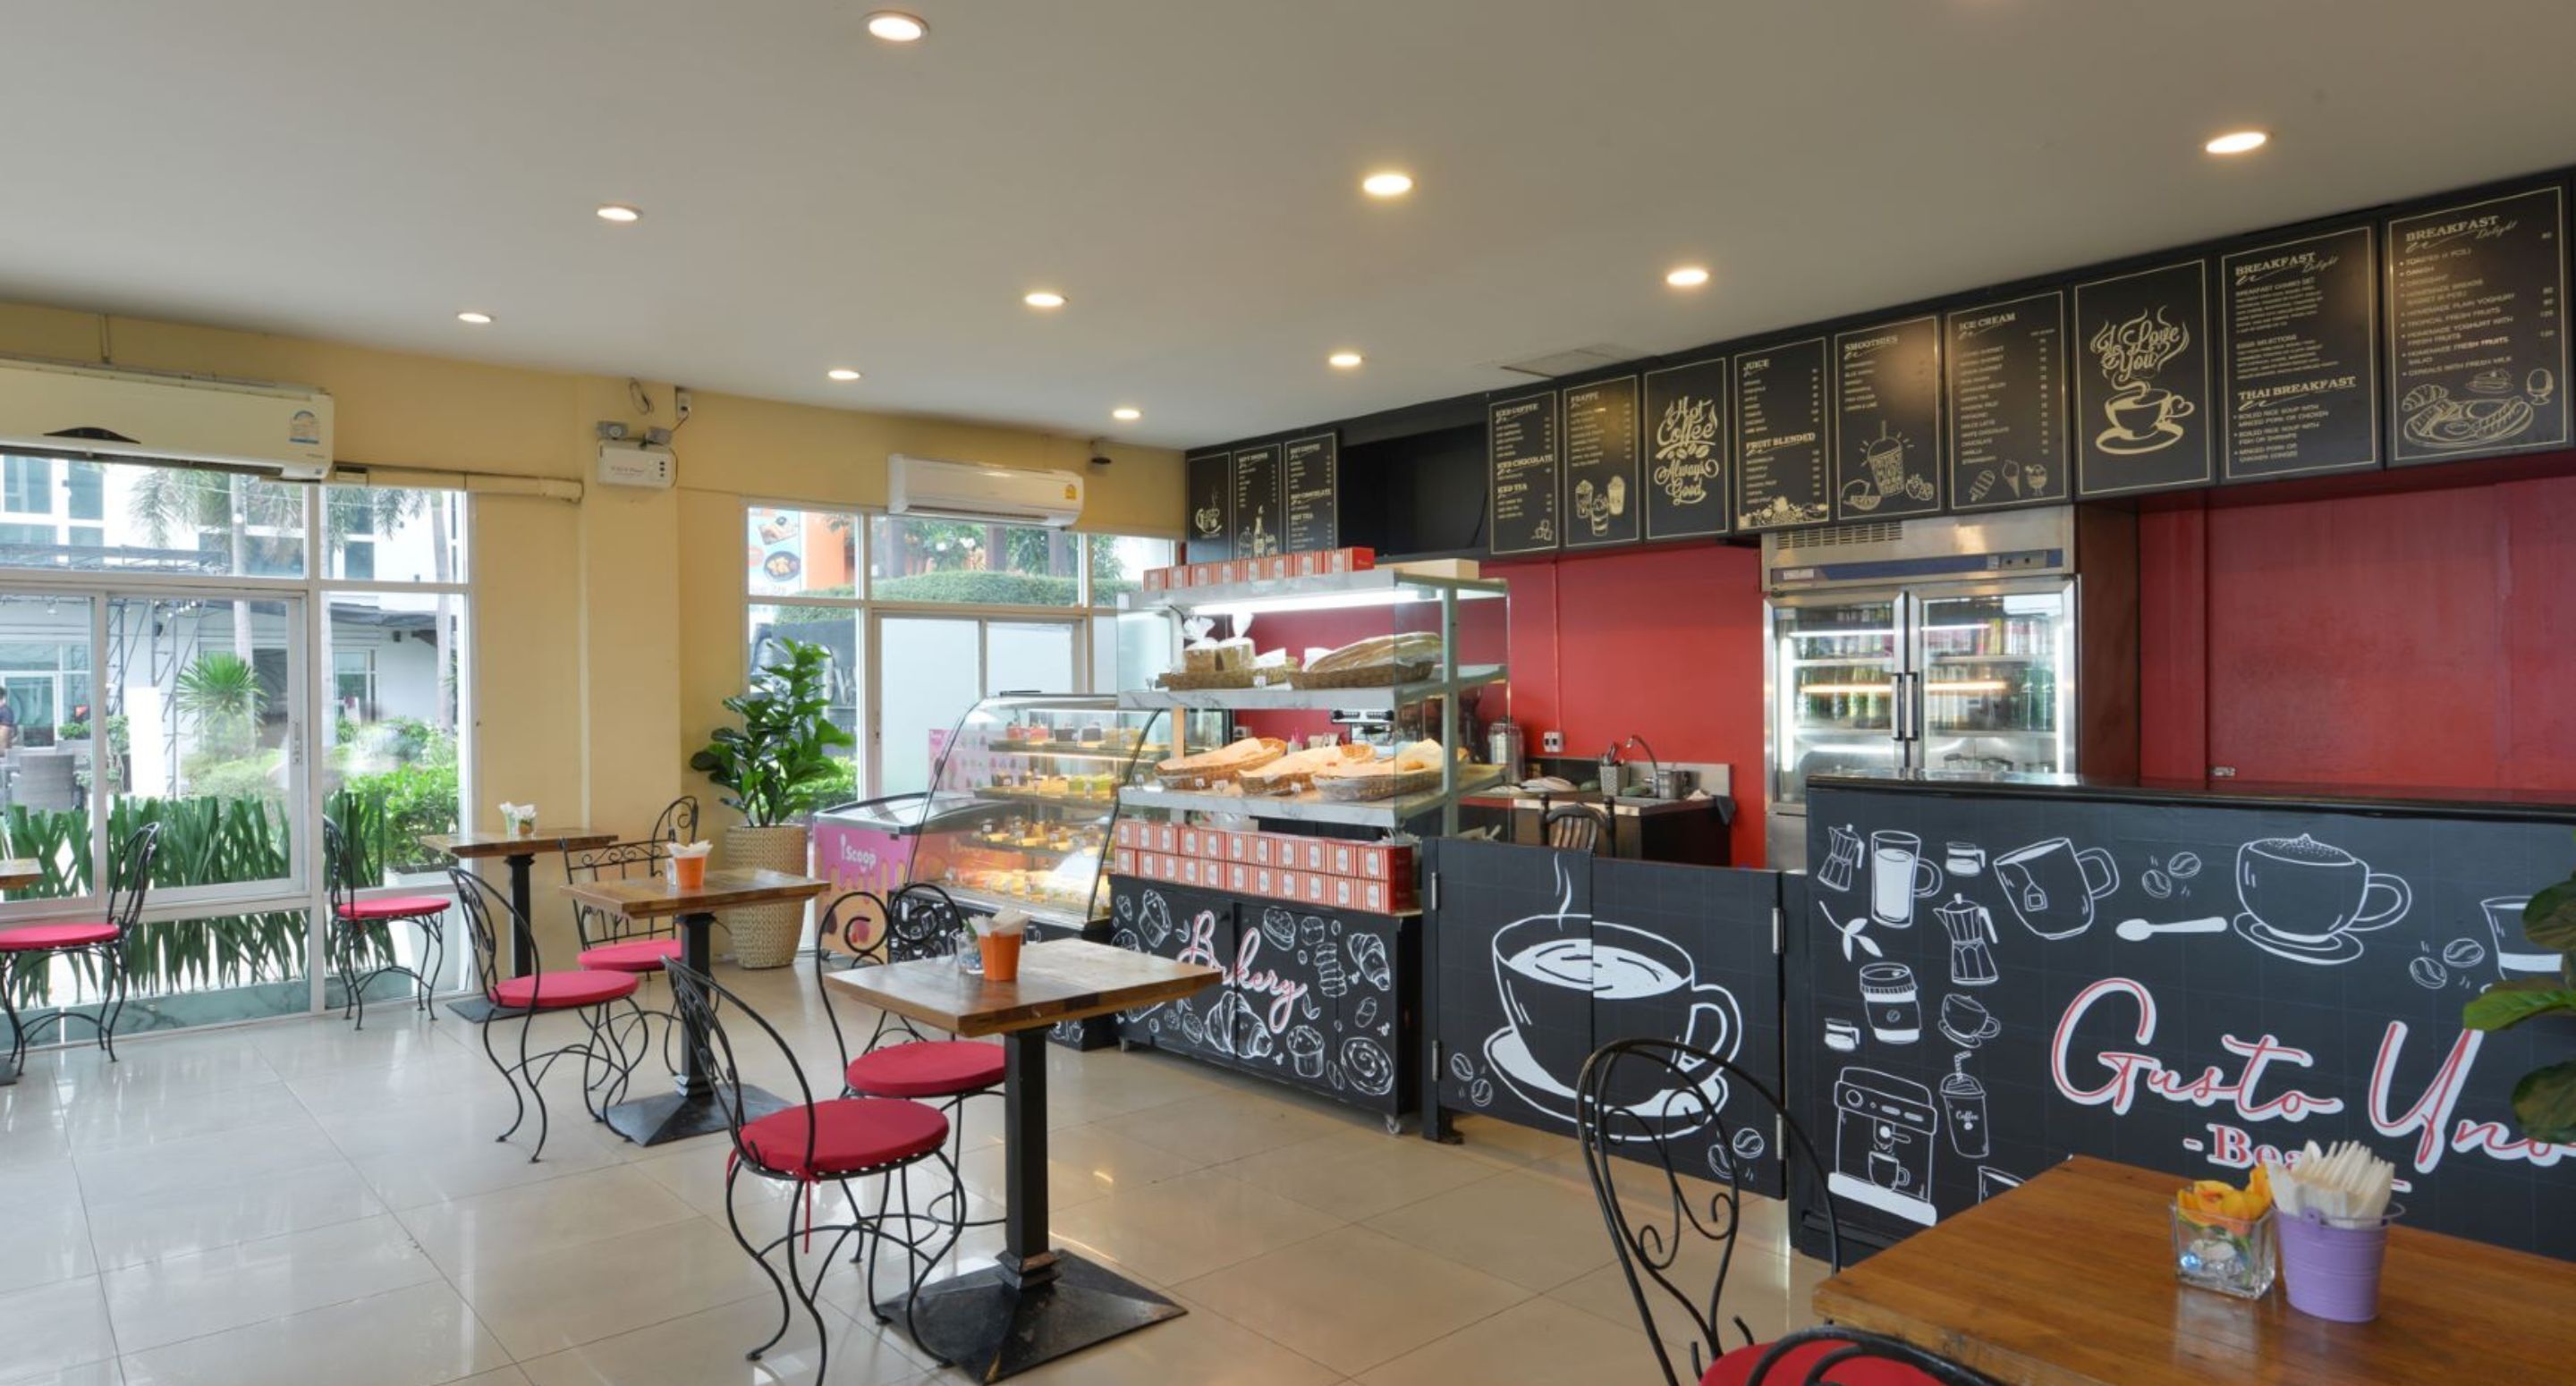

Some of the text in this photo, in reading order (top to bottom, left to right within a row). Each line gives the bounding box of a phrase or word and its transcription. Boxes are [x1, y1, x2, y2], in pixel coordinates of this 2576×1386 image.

[2405, 216, 2500, 242] BREAKFAST
[2234, 250, 2317, 277] BREAKFAST
[1958, 312, 2017, 332] ICE CREAM
[1844, 334, 1899, 352] SMOOTHIES
[1743, 358, 1771, 371] JUICE
[1570, 391, 1600, 403] FRAPPE
[2237, 375, 2358, 402] THAI BREAKFAST
[1657, 415, 1716, 447] Coffee
[1745, 431, 1817, 451] FRUIT BLENDED
[1513, 453, 1555, 467] CHOCOLATE
[1654, 459, 1719, 486] Always
[1665, 478, 1707, 506] Good
[2051, 976, 2576, 1174] Gusto Uno
